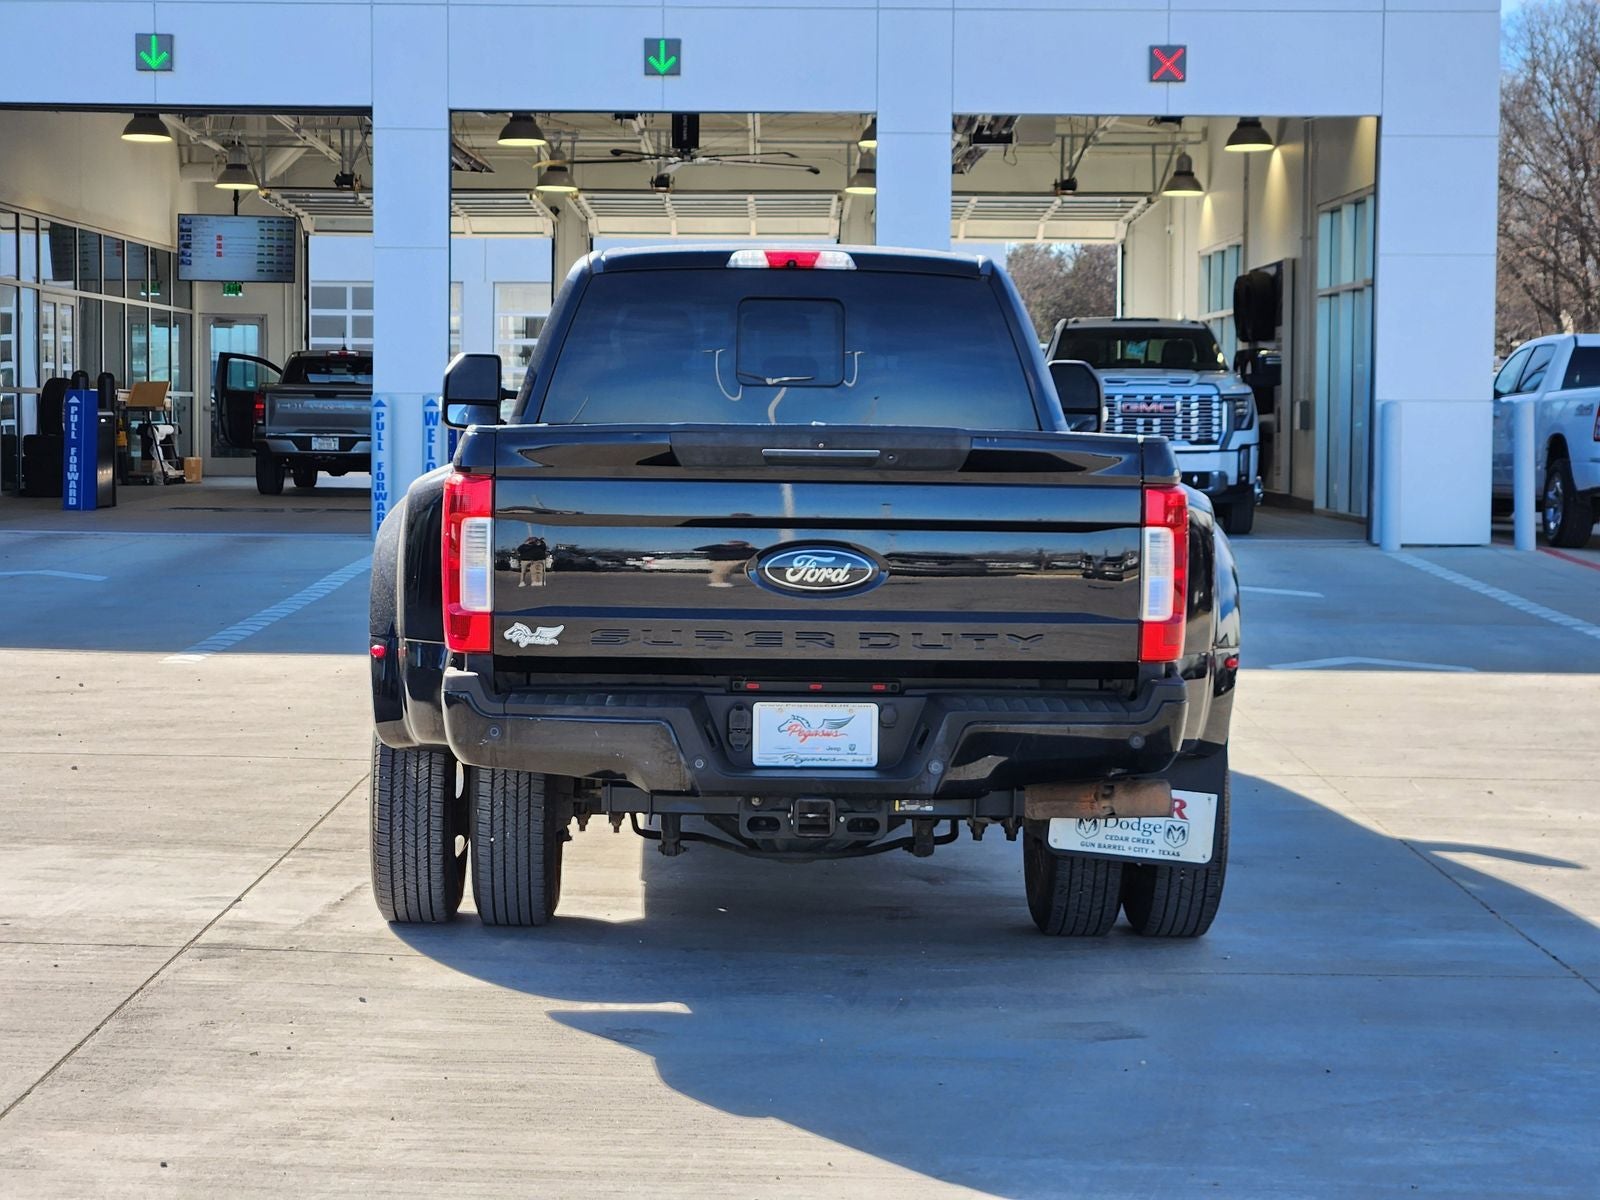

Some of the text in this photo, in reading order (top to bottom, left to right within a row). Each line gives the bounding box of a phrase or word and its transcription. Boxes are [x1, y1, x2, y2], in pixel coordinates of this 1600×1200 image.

[1121, 402, 1177, 413] GMC
[67, 406, 80, 506] PULL FORWARD
[374, 411, 388, 532] PULL FORWAR
[785, 554, 852, 583] Ford
[590, 628, 1044, 651] SUPER DUTY
[1103, 817, 1163, 837] Dodge
[1080, 840, 1181, 857] GUN BARREL CITY TEXAS
[1104, 834, 1156, 846] CEDAR CREEK
